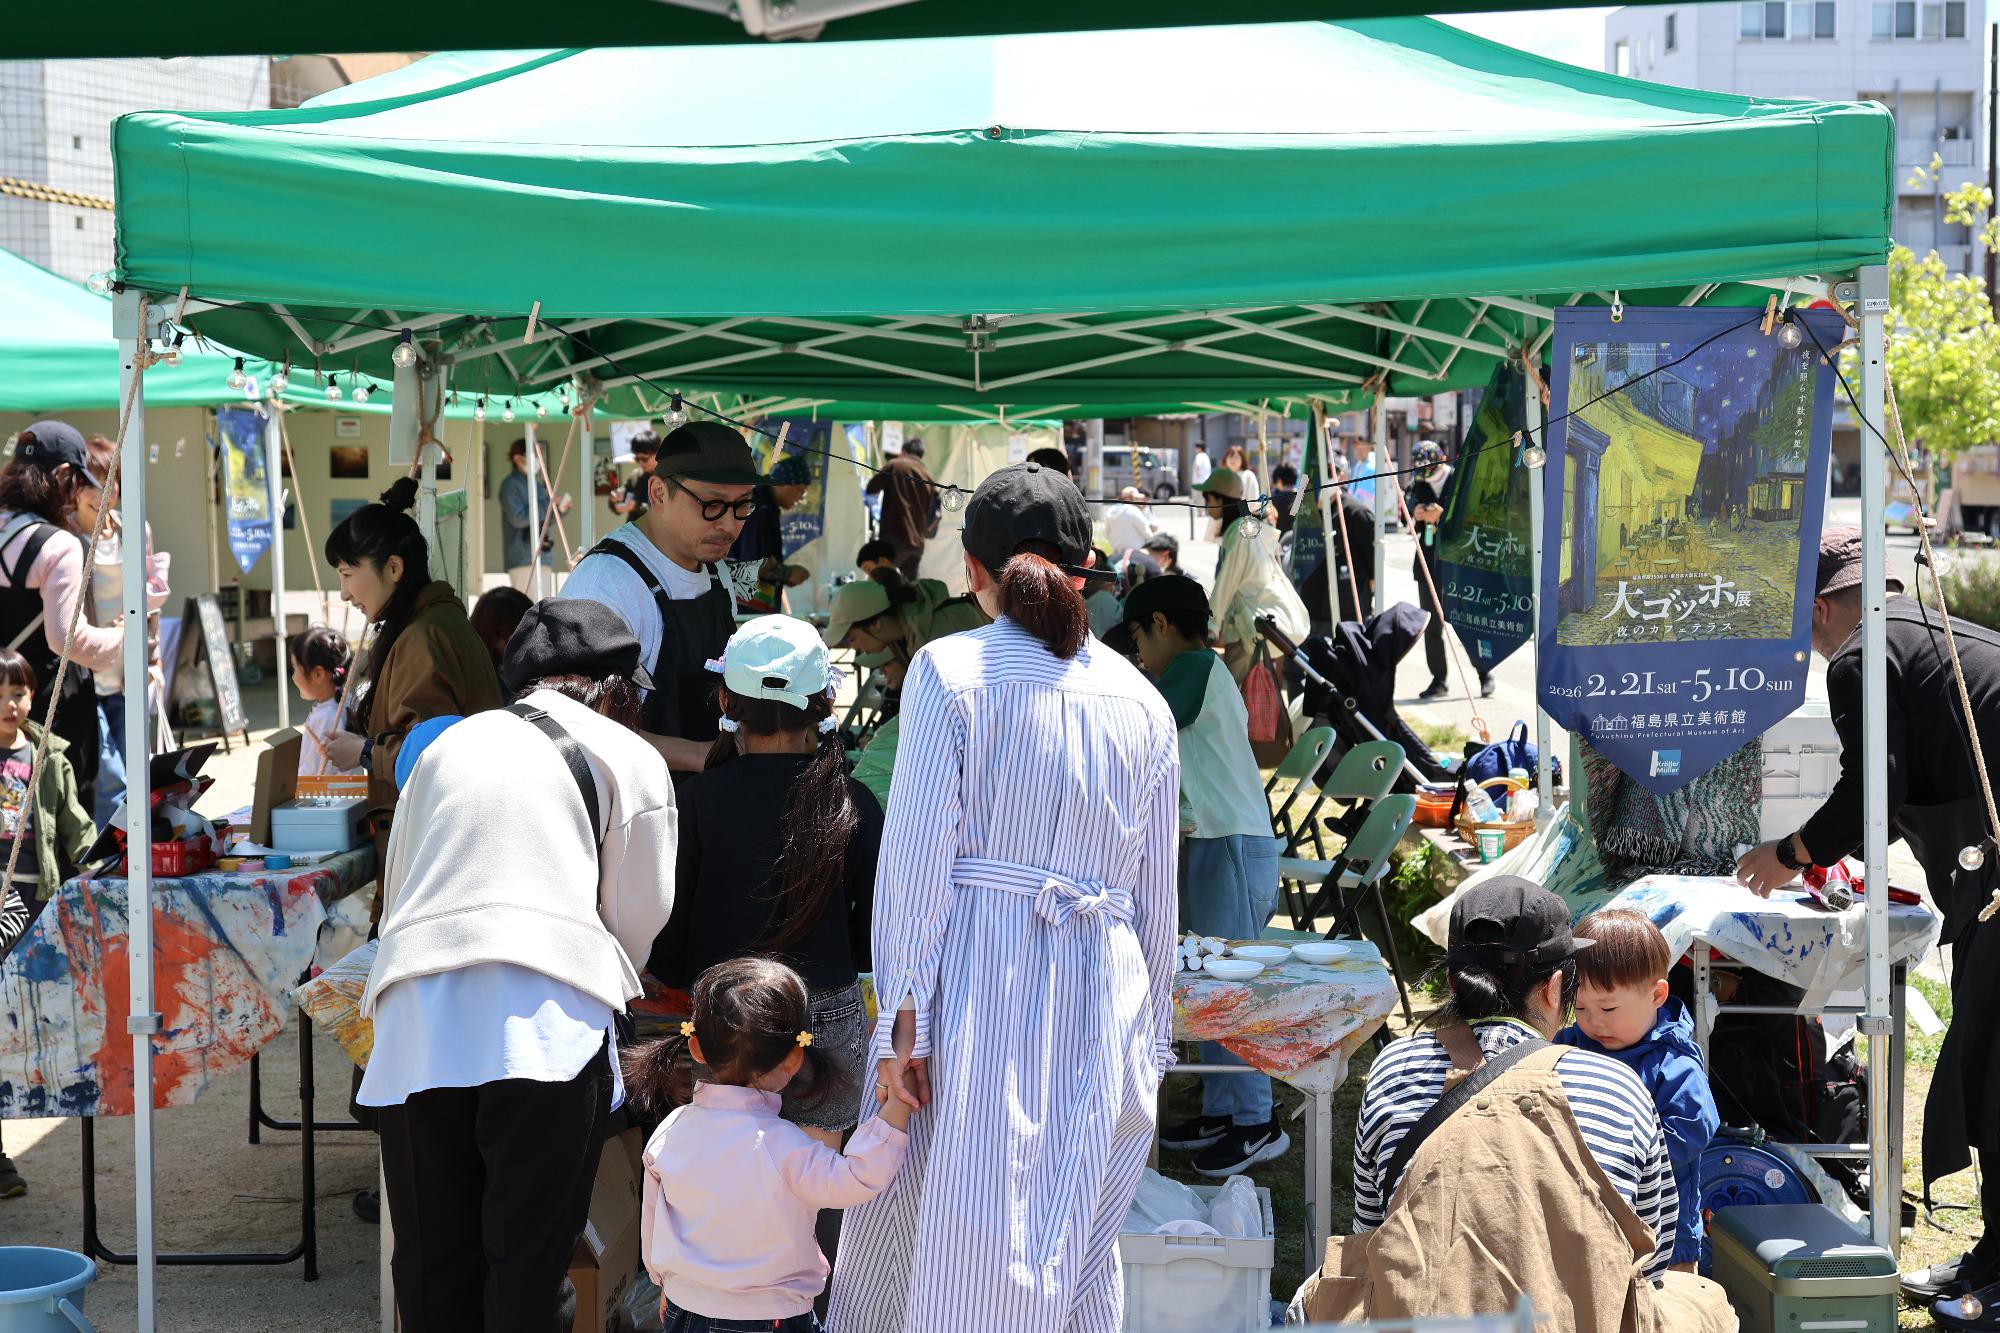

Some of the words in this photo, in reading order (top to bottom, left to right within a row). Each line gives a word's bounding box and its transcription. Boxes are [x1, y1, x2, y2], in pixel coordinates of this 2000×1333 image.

[1600, 575, 1752, 622] 大ゴッホ展
[1616, 622, 1733, 637] 夜のカフェテラス
[1549, 685, 1582, 699] 2026
[1630, 708, 1747, 729] 福島県立美術館
[1637, 730, 1684, 738] Prefectural
